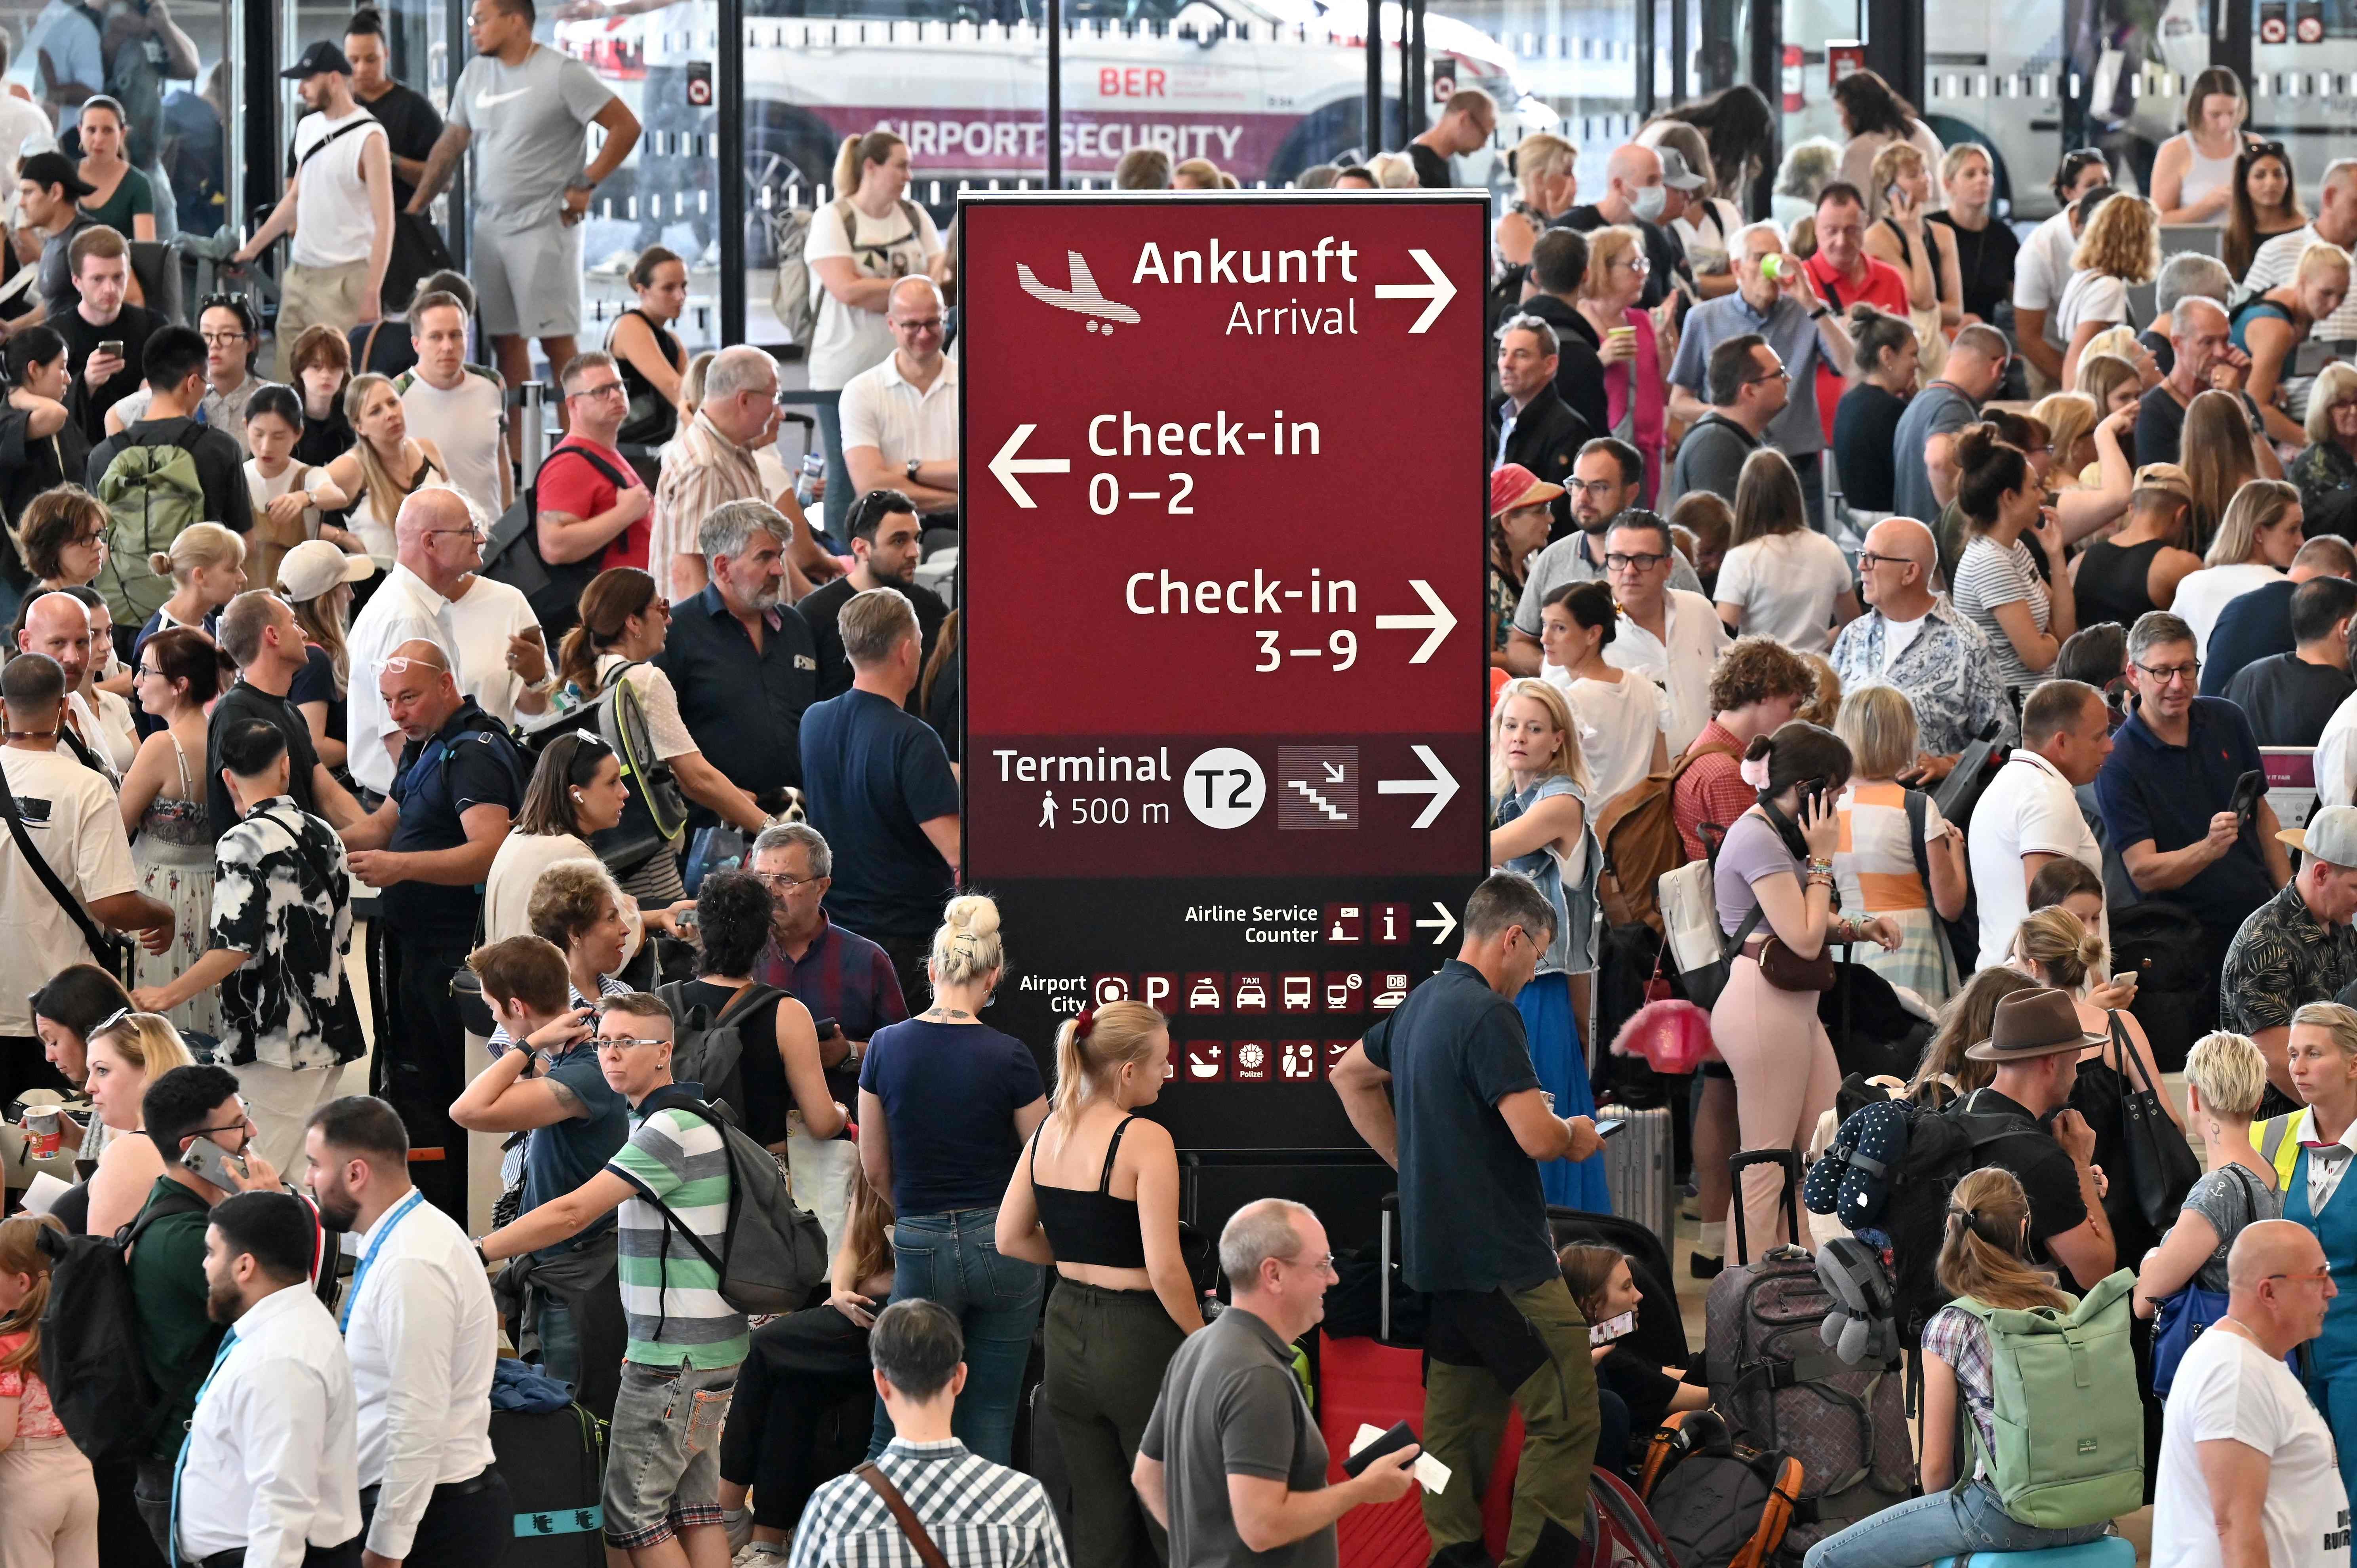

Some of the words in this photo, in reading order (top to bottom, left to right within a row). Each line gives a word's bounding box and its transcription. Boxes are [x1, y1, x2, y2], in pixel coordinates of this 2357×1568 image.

[1099, 66, 1165, 97] BER
[1132, 236, 1358, 284] Ankunft
[1225, 298, 1358, 335] Arrival
[1089, 410, 1319, 456] Check-in
[1126, 568, 1356, 614] Check-in
[993, 747, 1171, 782] Terminal
[1195, 769, 1252, 808] T2
[1072, 798, 1129, 824] 500
[1143, 803, 1169, 823] m
[1185, 905, 1246, 921] Airline
[1253, 905, 1317, 921] Service
[1245, 927, 1318, 943] Counter
[1020, 974, 1086, 995] Airport
[1147, 977, 1169, 1009] P
[1388, 976, 1405, 987] DB
[1051, 996, 1086, 1016] City
